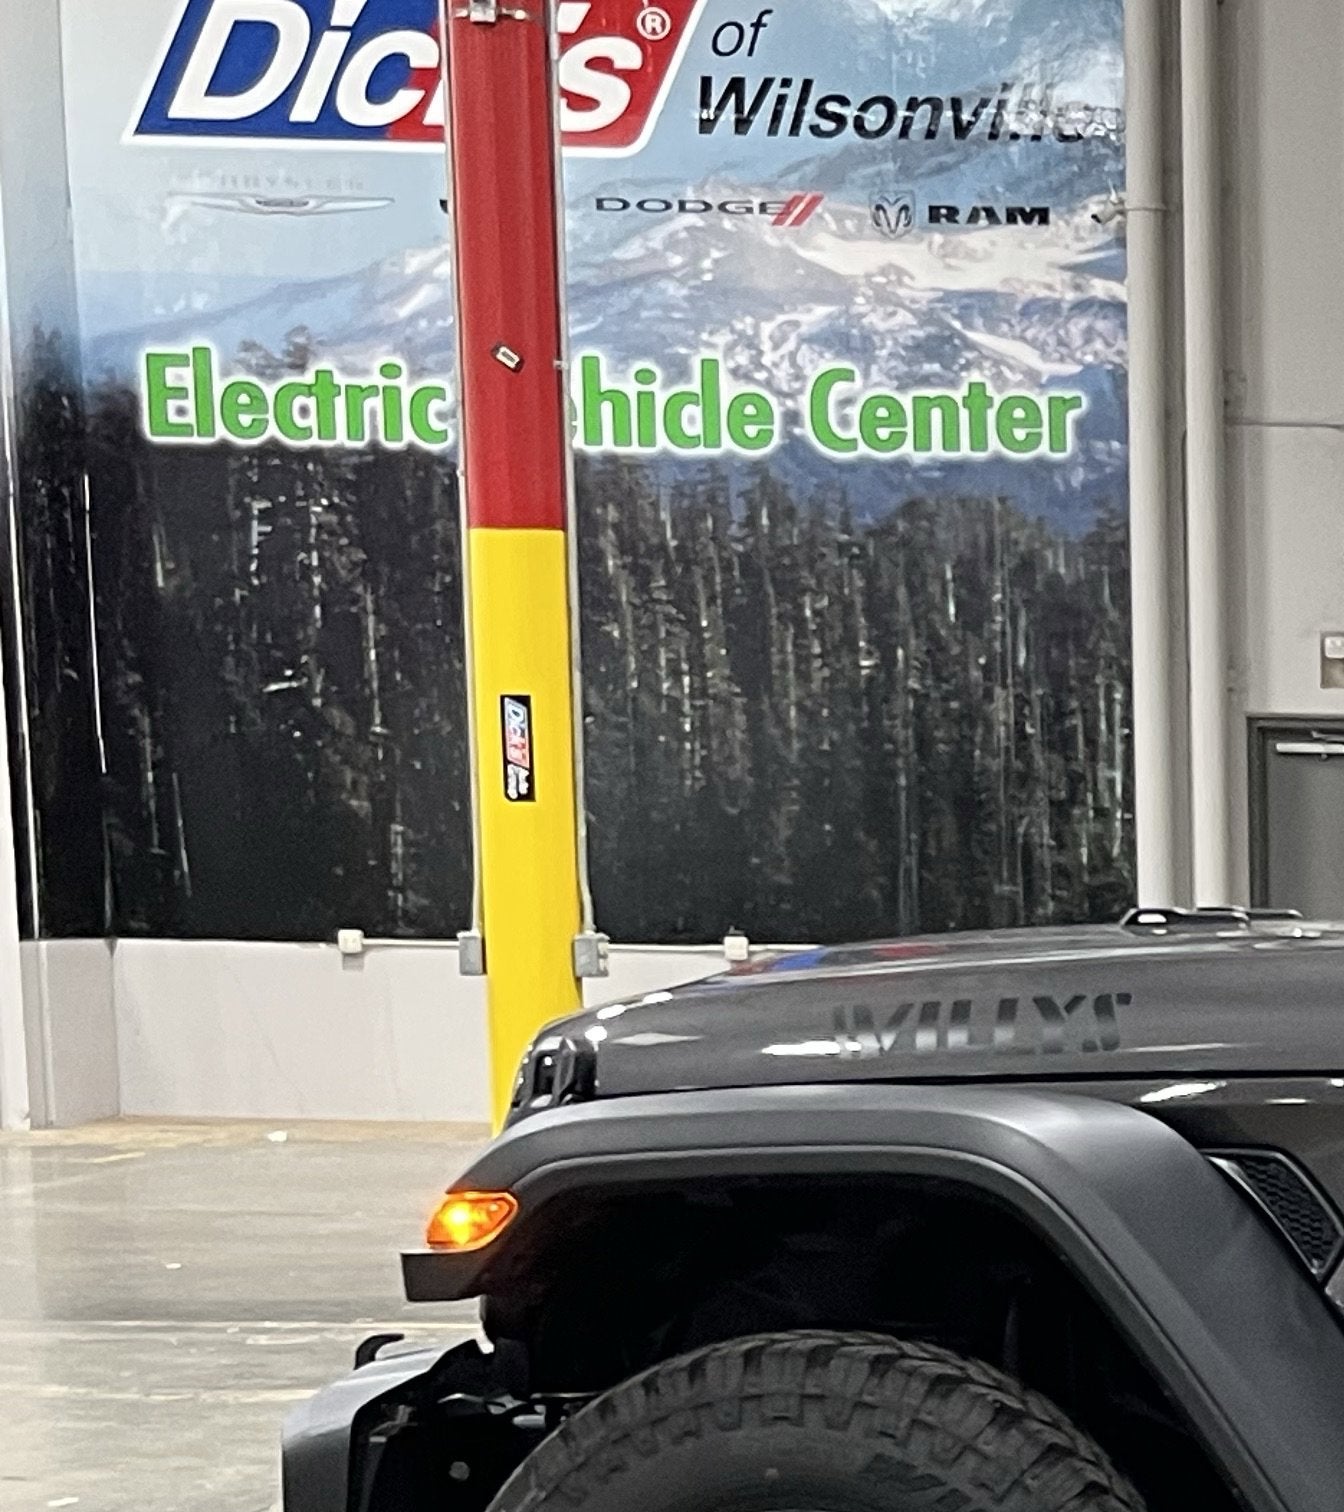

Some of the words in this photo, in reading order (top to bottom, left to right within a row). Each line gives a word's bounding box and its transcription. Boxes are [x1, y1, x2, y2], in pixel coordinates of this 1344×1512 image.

[711, 9, 774, 57] of
[168, 0, 644, 132] Dic's
[698, 75, 1088, 143] Wilsonvi
[595, 197, 784, 215] DODGE
[928, 204, 1051, 226] RAM
[145, 346, 449, 445] Electric
[573, 356, 775, 450] hicle
[810, 367, 1083, 454] Center
